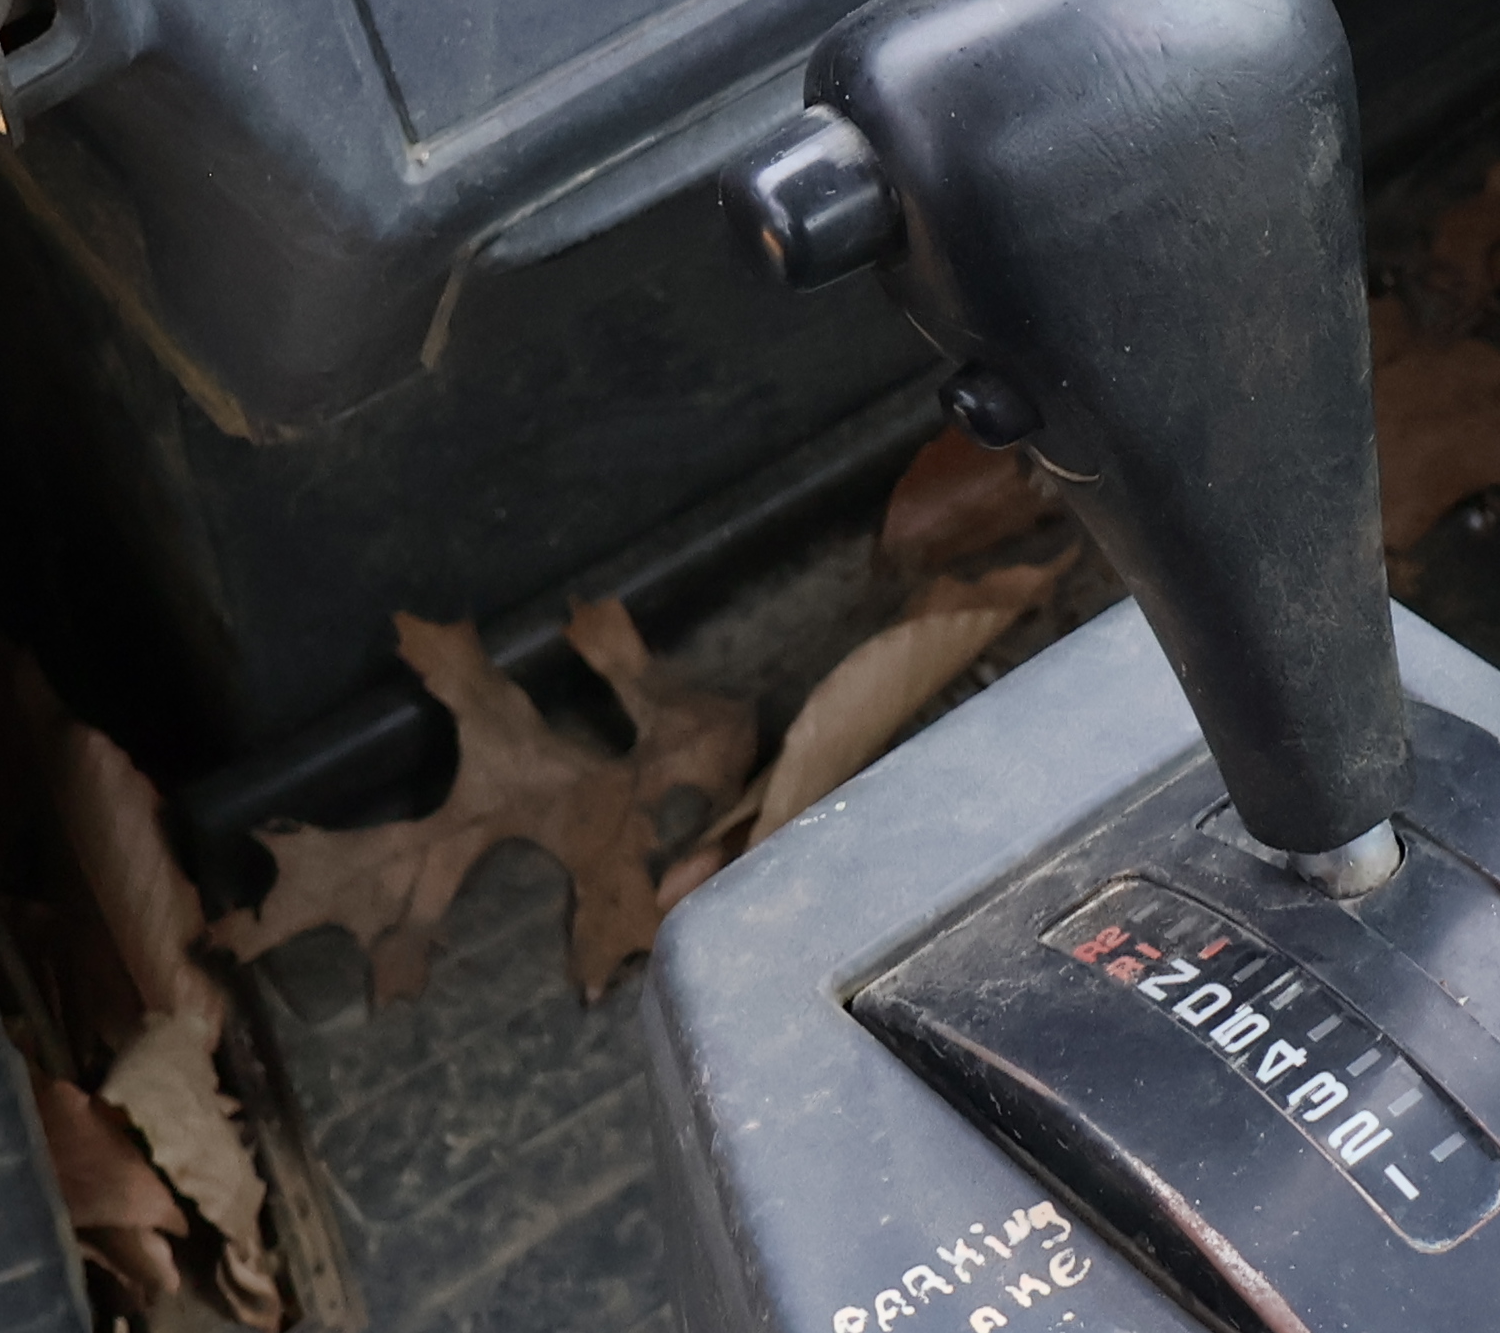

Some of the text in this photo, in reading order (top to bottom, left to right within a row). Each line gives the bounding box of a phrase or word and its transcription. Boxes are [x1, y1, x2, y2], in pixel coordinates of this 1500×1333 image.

[1136, 957, 1202, 1003] N
[1171, 982, 1234, 1028] D
[1255, 1038, 1309, 1084] 4
[1285, 1070, 1350, 1123] 3
[1327, 1109, 1395, 1167] 2
